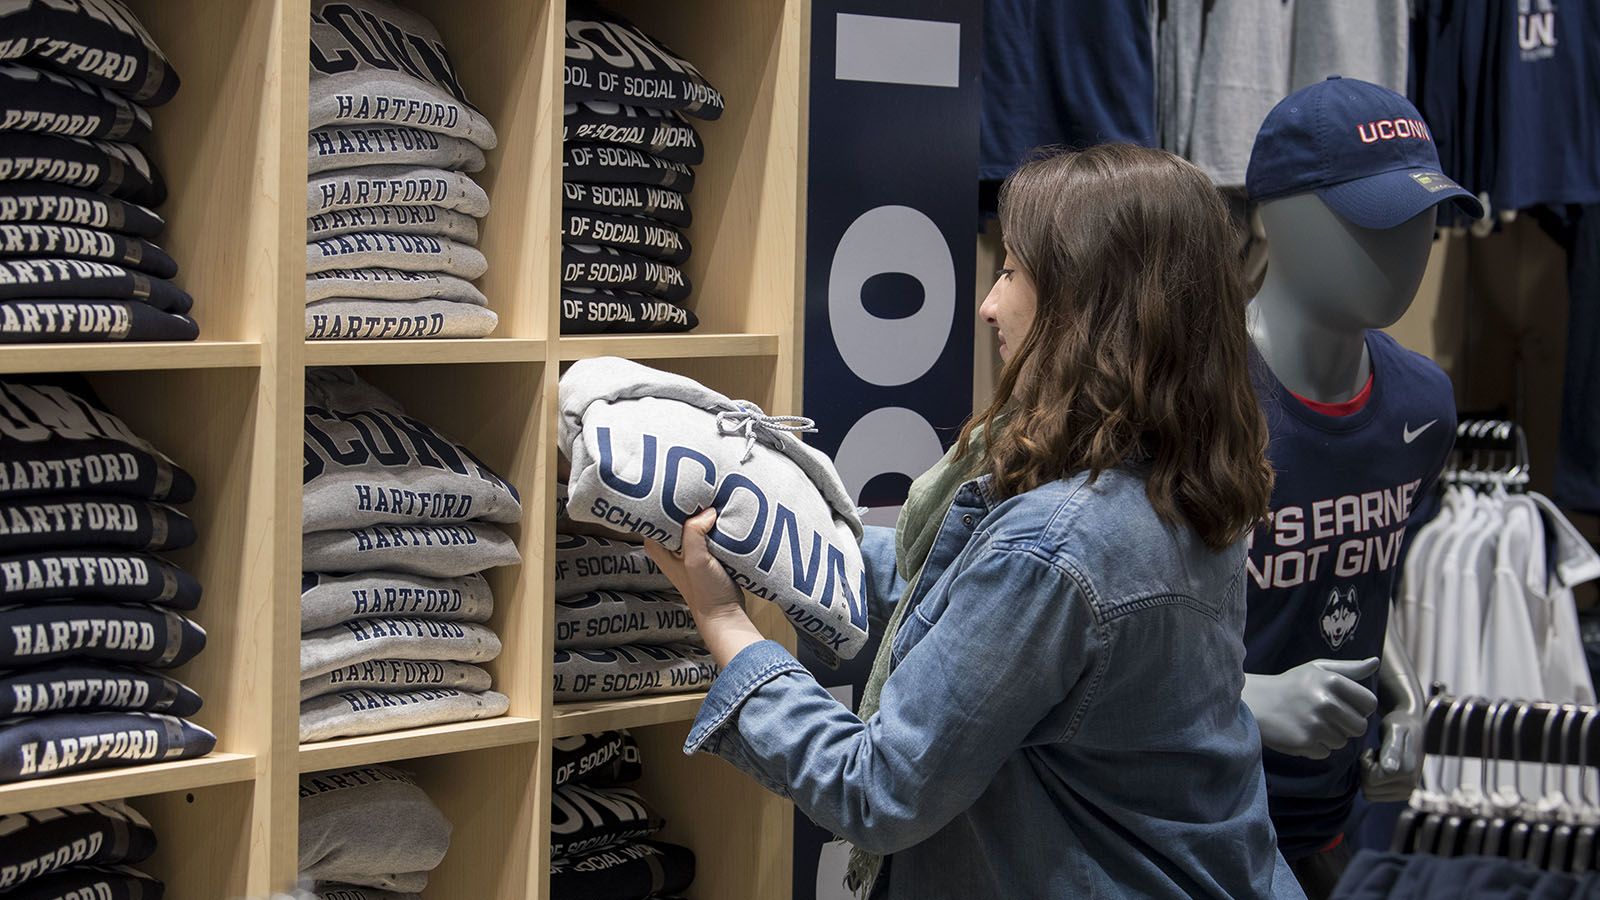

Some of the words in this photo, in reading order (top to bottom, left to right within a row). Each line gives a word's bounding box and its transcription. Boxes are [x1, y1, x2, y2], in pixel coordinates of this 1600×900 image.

[599, 72, 619, 92] OF
[624, 77, 677, 99] SOCIAL
[682, 81, 724, 109] WORK
[335, 95, 460, 129] HARTFORD
[311, 127, 440, 156] HARTFORD
[651, 127, 696, 148] WORK
[1356, 117, 1430, 145] UCONN
[571, 149, 593, 166] OF
[599, 149, 650, 168] SOCIAL
[320, 179, 448, 209] HARTFORD
[564, 183, 587, 201] OF
[592, 186, 643, 207] SOCIAL
[647, 188, 684, 211] WORK
[310, 205, 438, 231] HARTFORD
[0, 225, 115, 258] RTFORD
[316, 231, 442, 256] HARTFORD
[570, 216, 591, 236] OF
[592, 219, 640, 243] SOCIAL
[645, 226, 683, 250] WORK
[564, 263, 585, 281] OF
[588, 263, 638, 282] SOCIAL
[645, 263, 684, 286] WORK
[309, 313, 444, 338] HARTFORD
[563, 300, 583, 319] OF
[588, 302, 635, 322] SOCIAL
[641, 302, 688, 325] WORK
[355, 485, 473, 518] HARTFORD
[1312, 479, 1422, 540] EARNE
[350, 526, 478, 551] HARTFORD
[597, 426, 869, 633] UCONN
[1, 557, 149, 592] HARTFORD
[576, 556, 640, 577] SOCIAL
[351, 588, 462, 614] HARTFORD
[12, 619, 155, 656] HARTFORD
[343, 618, 466, 641] HARTFORD
[557, 621, 581, 641] OF
[586, 612, 649, 637] SOCIAL
[656, 610, 697, 629] WOR
[786, 604, 849, 651] WORK
[330, 660, 444, 684] HARTFORD
[572, 675, 597, 693] OF
[601, 671, 663, 692] SOCIAL
[670, 663, 718, 687] WORK
[12, 679, 149, 713] HARTFORD
[20, 730, 158, 776] HARTFORD
[556, 762, 575, 784] OF
